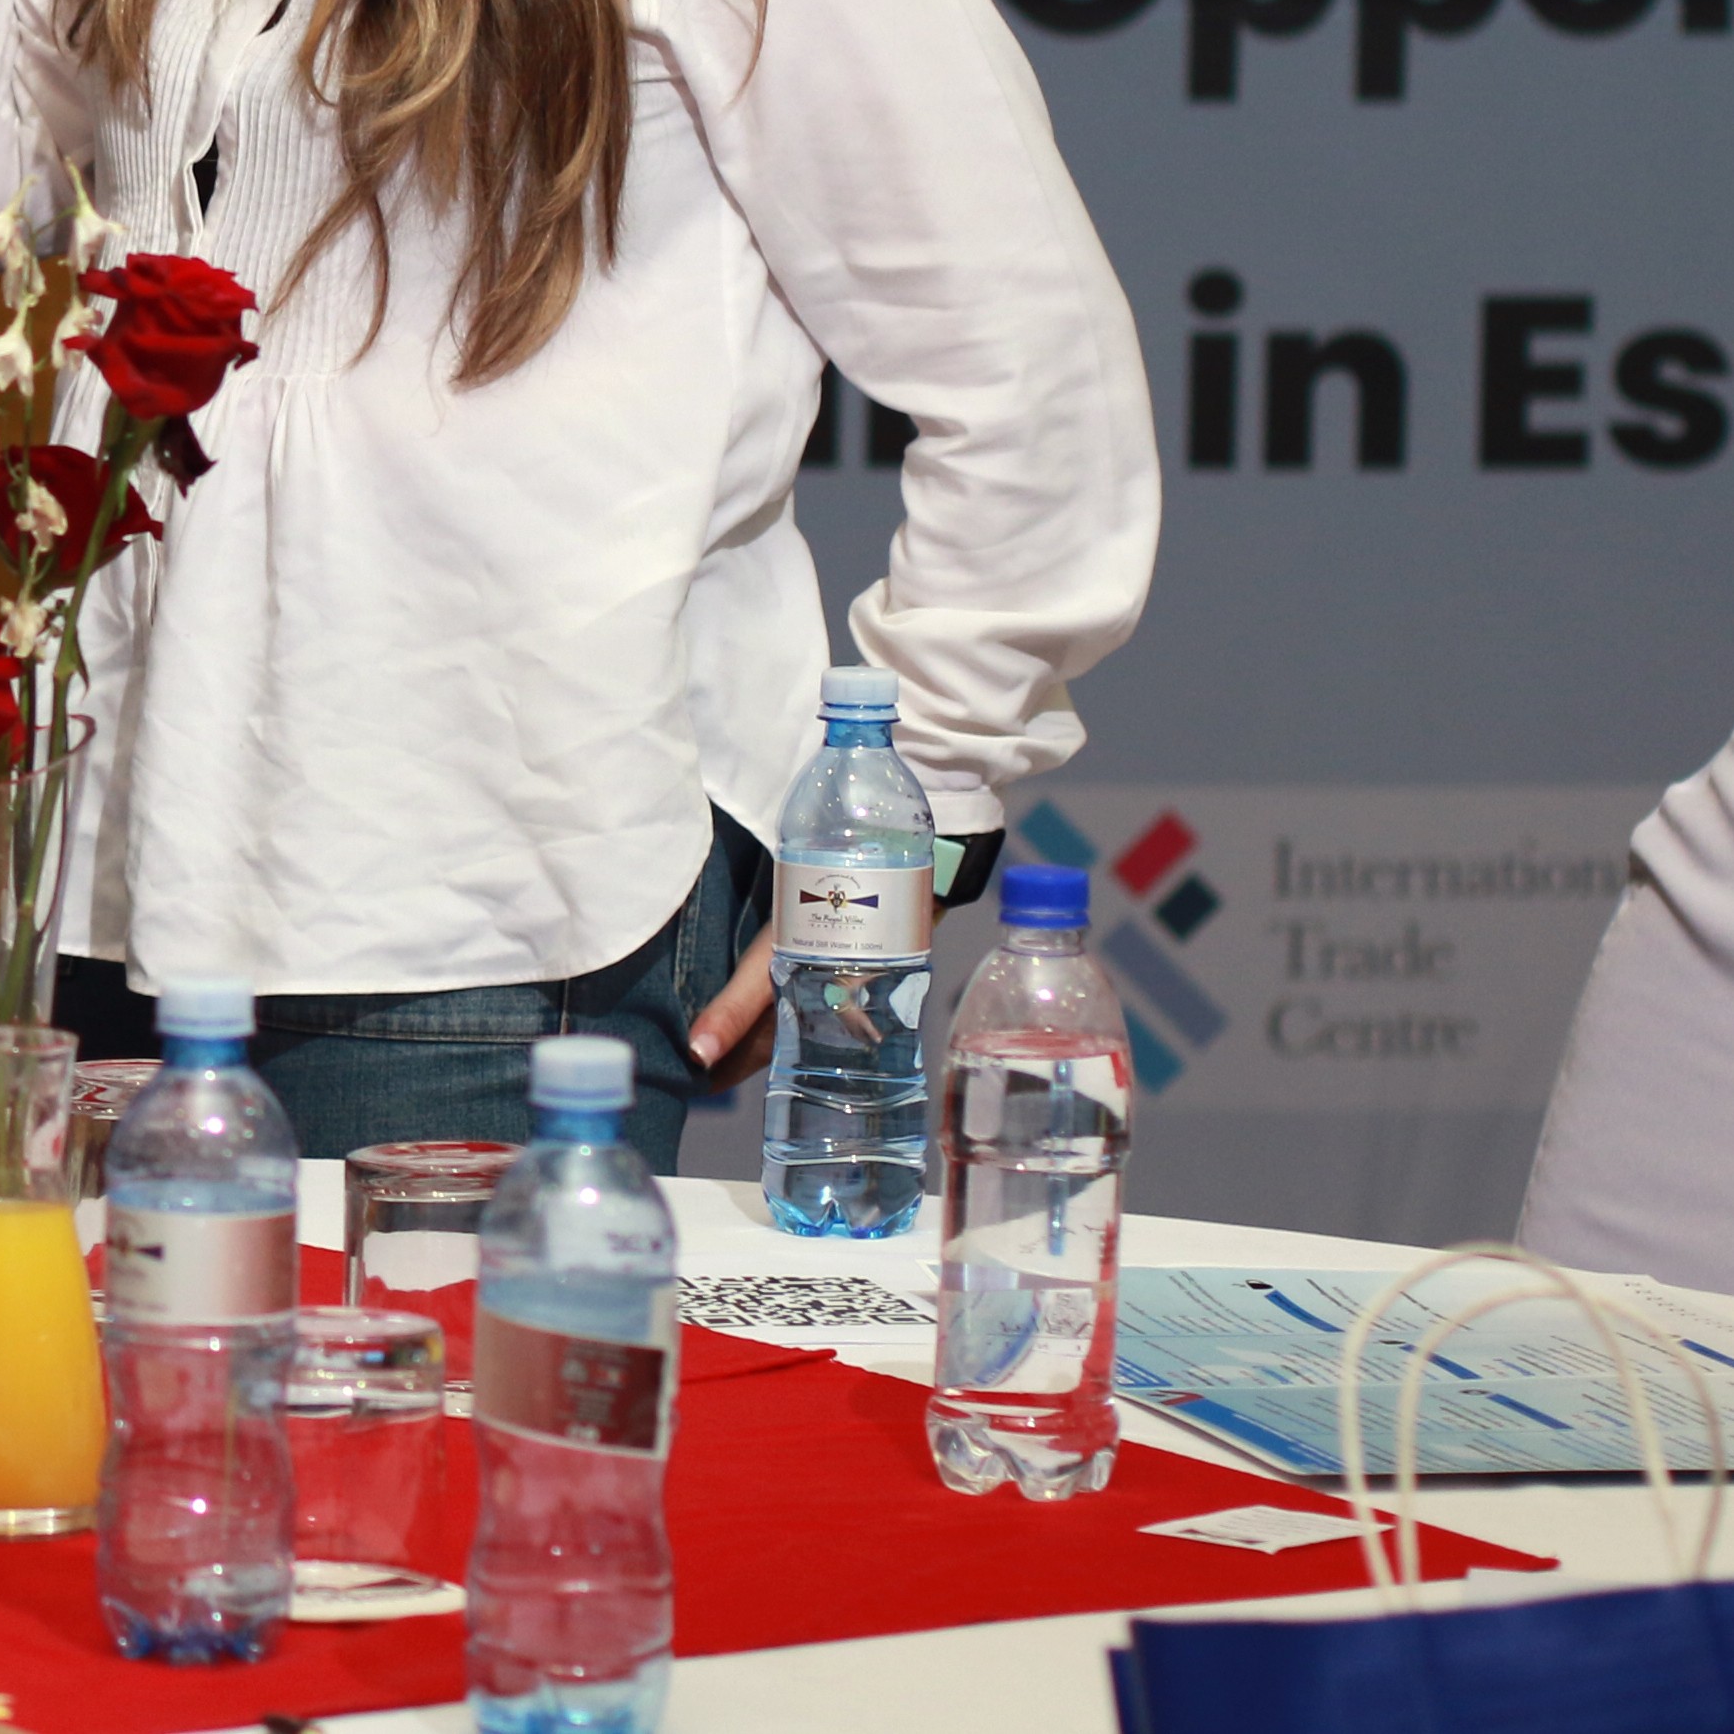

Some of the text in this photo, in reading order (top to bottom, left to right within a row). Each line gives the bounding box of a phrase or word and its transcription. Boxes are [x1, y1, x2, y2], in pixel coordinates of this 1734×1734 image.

[1184, 269, 1734, 474] in Es
[1270, 918, 1454, 982] Trade
[1266, 995, 1479, 1059] Centre
